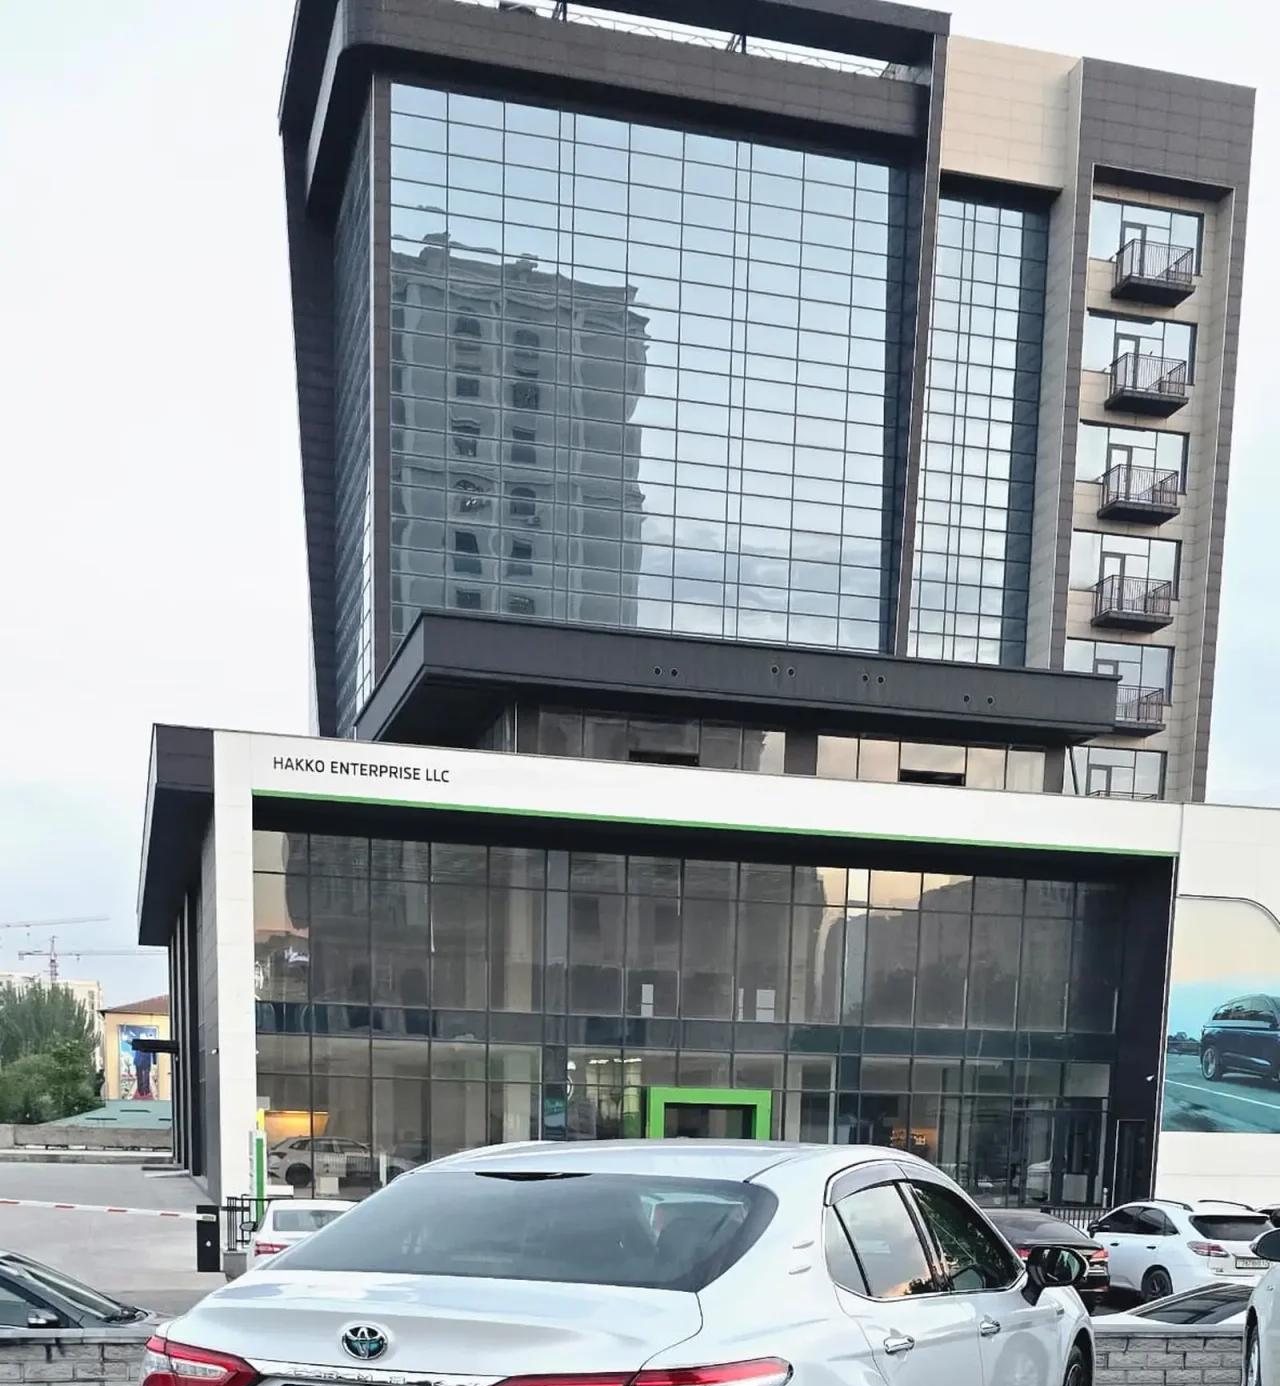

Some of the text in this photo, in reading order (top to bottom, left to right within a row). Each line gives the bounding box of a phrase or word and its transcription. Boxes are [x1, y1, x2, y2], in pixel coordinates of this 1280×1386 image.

[273, 756, 450, 783] HAKKO ENTERPRISE LLC
